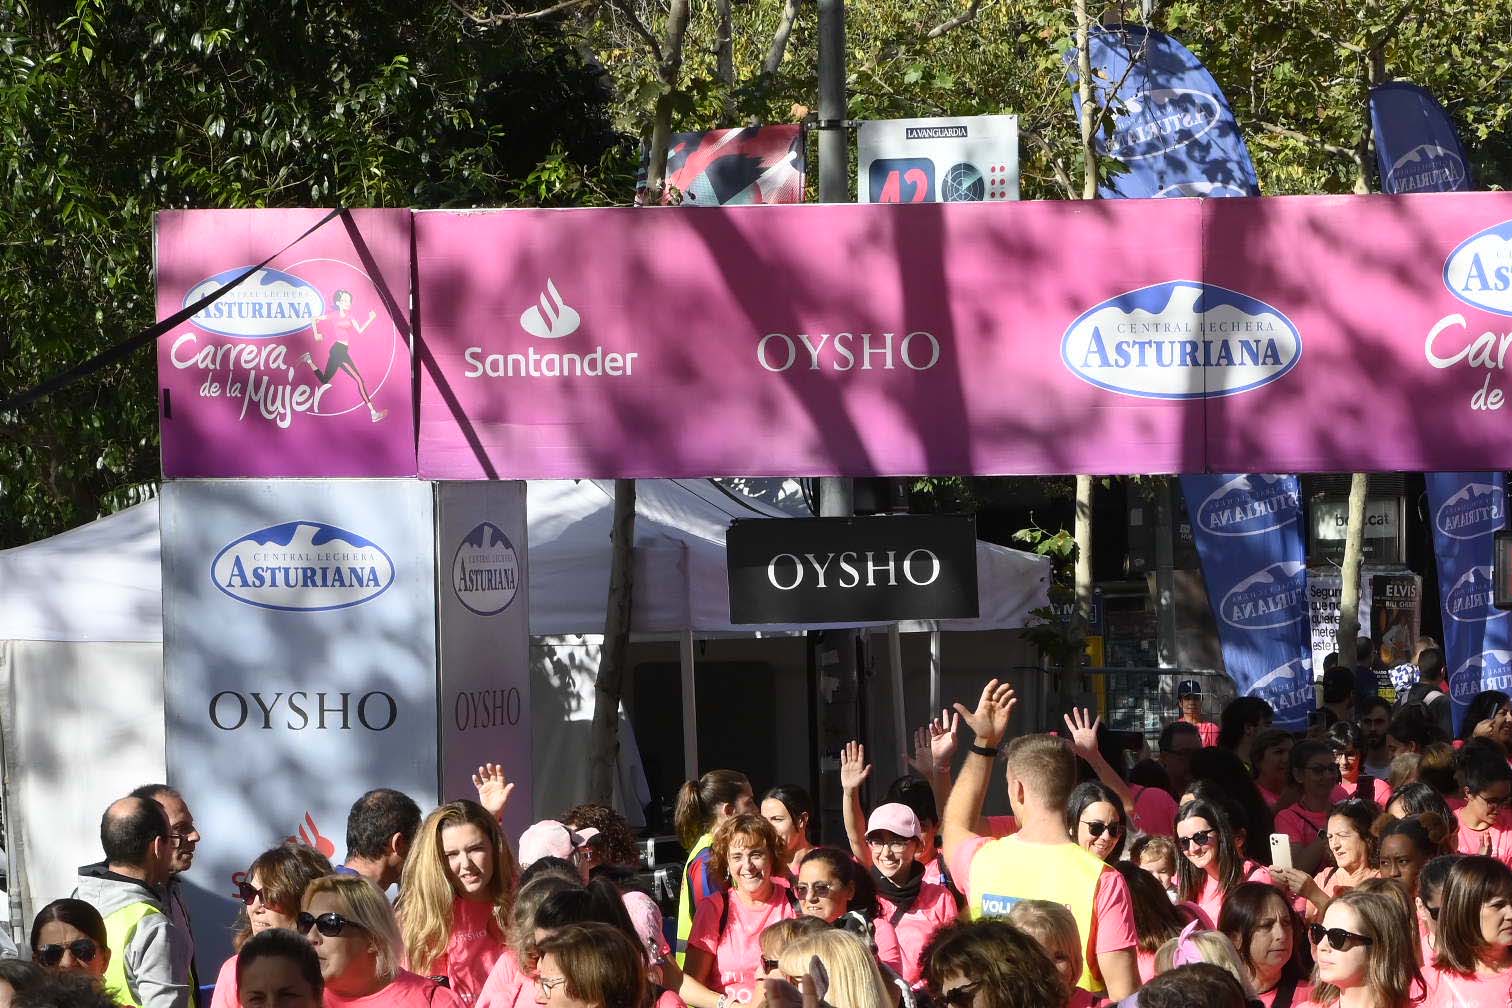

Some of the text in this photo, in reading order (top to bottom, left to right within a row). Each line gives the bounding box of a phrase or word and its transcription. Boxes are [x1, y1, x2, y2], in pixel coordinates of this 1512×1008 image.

[918, 128, 967, 138] VANGUARDIA
[194, 292, 313, 319] ASTURIANA
[1116, 321, 1277, 335] CENTRAL LECHERA
[170, 332, 288, 370] Carrera
[463, 345, 639, 379] Santander
[757, 330, 941, 373] OYSHO
[1079, 326, 1284, 369] ASTURIANA
[200, 367, 333, 429] de la Mujer
[1470, 372, 1505, 411] de
[226, 554, 382, 589] ASTURIANA
[253, 552, 375, 562] CENTRAL LECHERA
[457, 557, 517, 593] ASTURIANA
[767, 548, 941, 591] OYSHO
[1386, 584, 1418, 597] ELVIS
[1312, 615, 1341, 627] quiere
[208, 690, 398, 732] OYSHO
[454, 687, 523, 732] OYSHO
